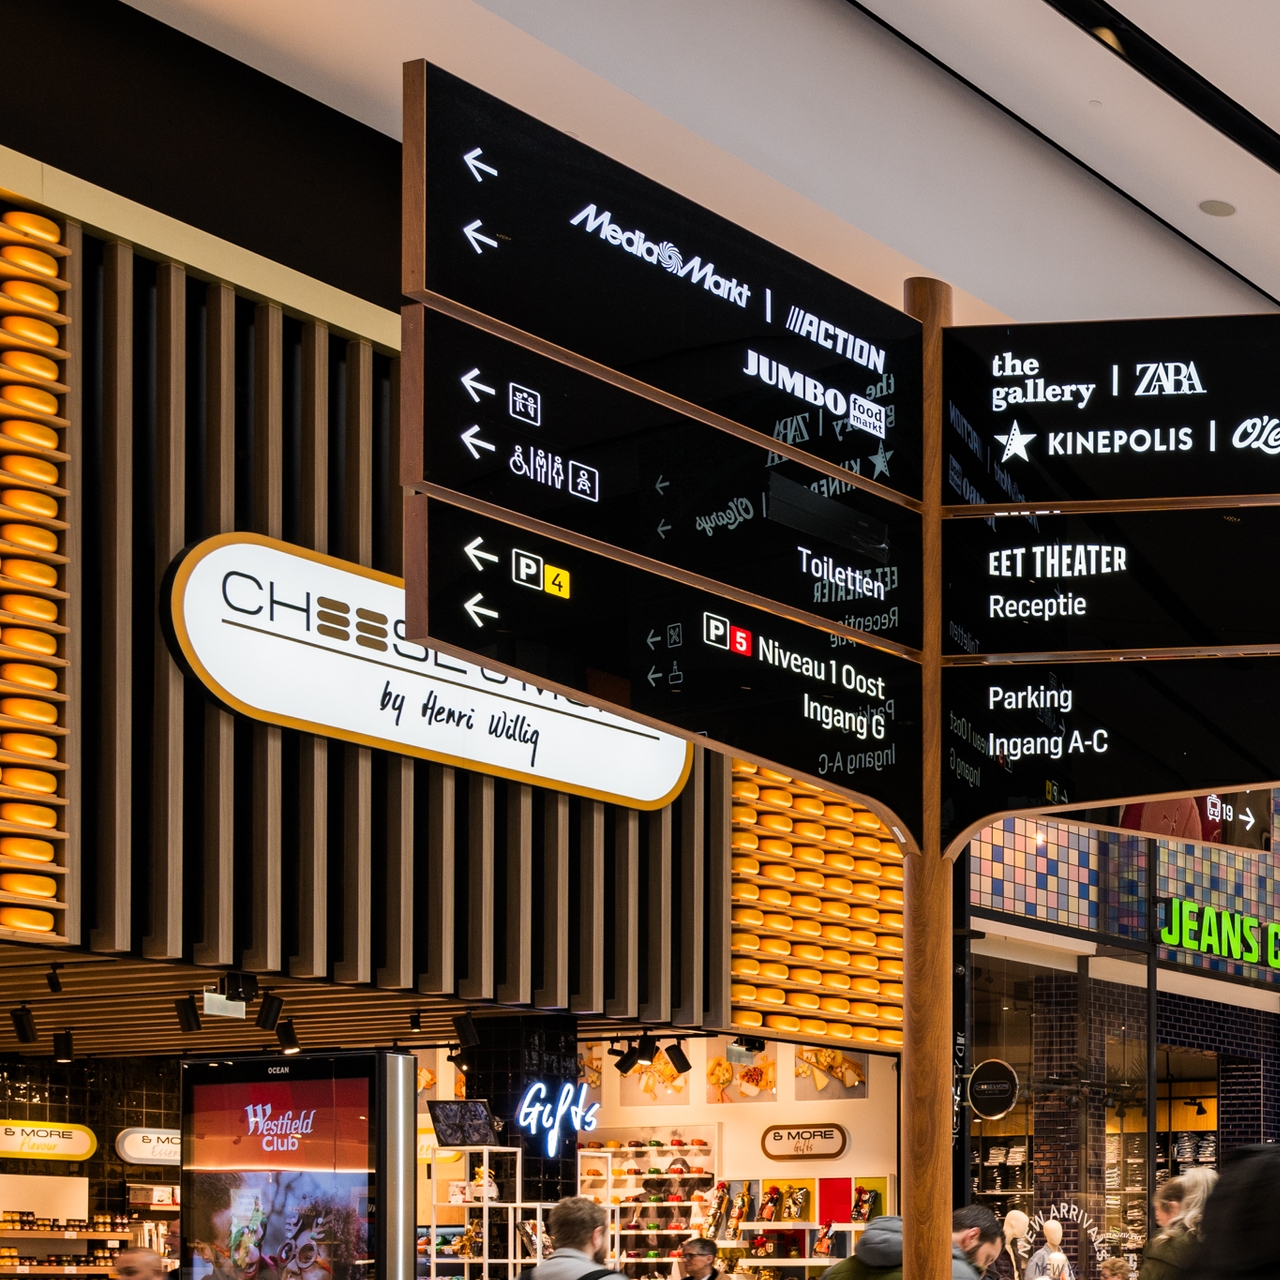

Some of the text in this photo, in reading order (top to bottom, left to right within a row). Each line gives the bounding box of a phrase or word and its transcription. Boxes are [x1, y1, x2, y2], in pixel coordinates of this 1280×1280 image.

[800, 311, 885, 374] ACTION
[743, 349, 847, 415] JUMBO
[992, 352, 1207, 396] the ZARA
[852, 397, 882, 423] food
[991, 377, 1096, 412] gallery
[852, 414, 882, 435] markt
[1048, 426, 1193, 456] KINEPOLIS
[797, 546, 885, 601] Toiletten
[989, 544, 1127, 578] EET THEATER
[551, 572, 564, 591] 4
[989, 592, 1087, 622] Receptie
[735, 631, 885, 700] 5 Niveau 1 Oost
[380, 680, 405, 726] by
[421, 690, 475, 731] Henri
[988, 684, 1073, 713] Parking
[803, 692, 886, 740] Ingang G
[988, 732, 1064, 761] Ingang
[1067, 728, 1109, 754] A-C
[1221, 803, 1234, 822] 19
[1161, 897, 1259, 964] JEANS
[267, 1066, 290, 1075] OCEAN
[4, 1127, 73, 1140] & MORE
[244, 1103, 317, 1136] Westfield
[517, 1081, 601, 1158] Gifts
[773, 1130, 834, 1141] & MORE
[142, 1135, 152, 1144] &
[262, 1136, 299, 1151] Club
[794, 1141, 813, 1153] Gifts
[1018, 1202, 1107, 1262] NEW ARRIVALS
